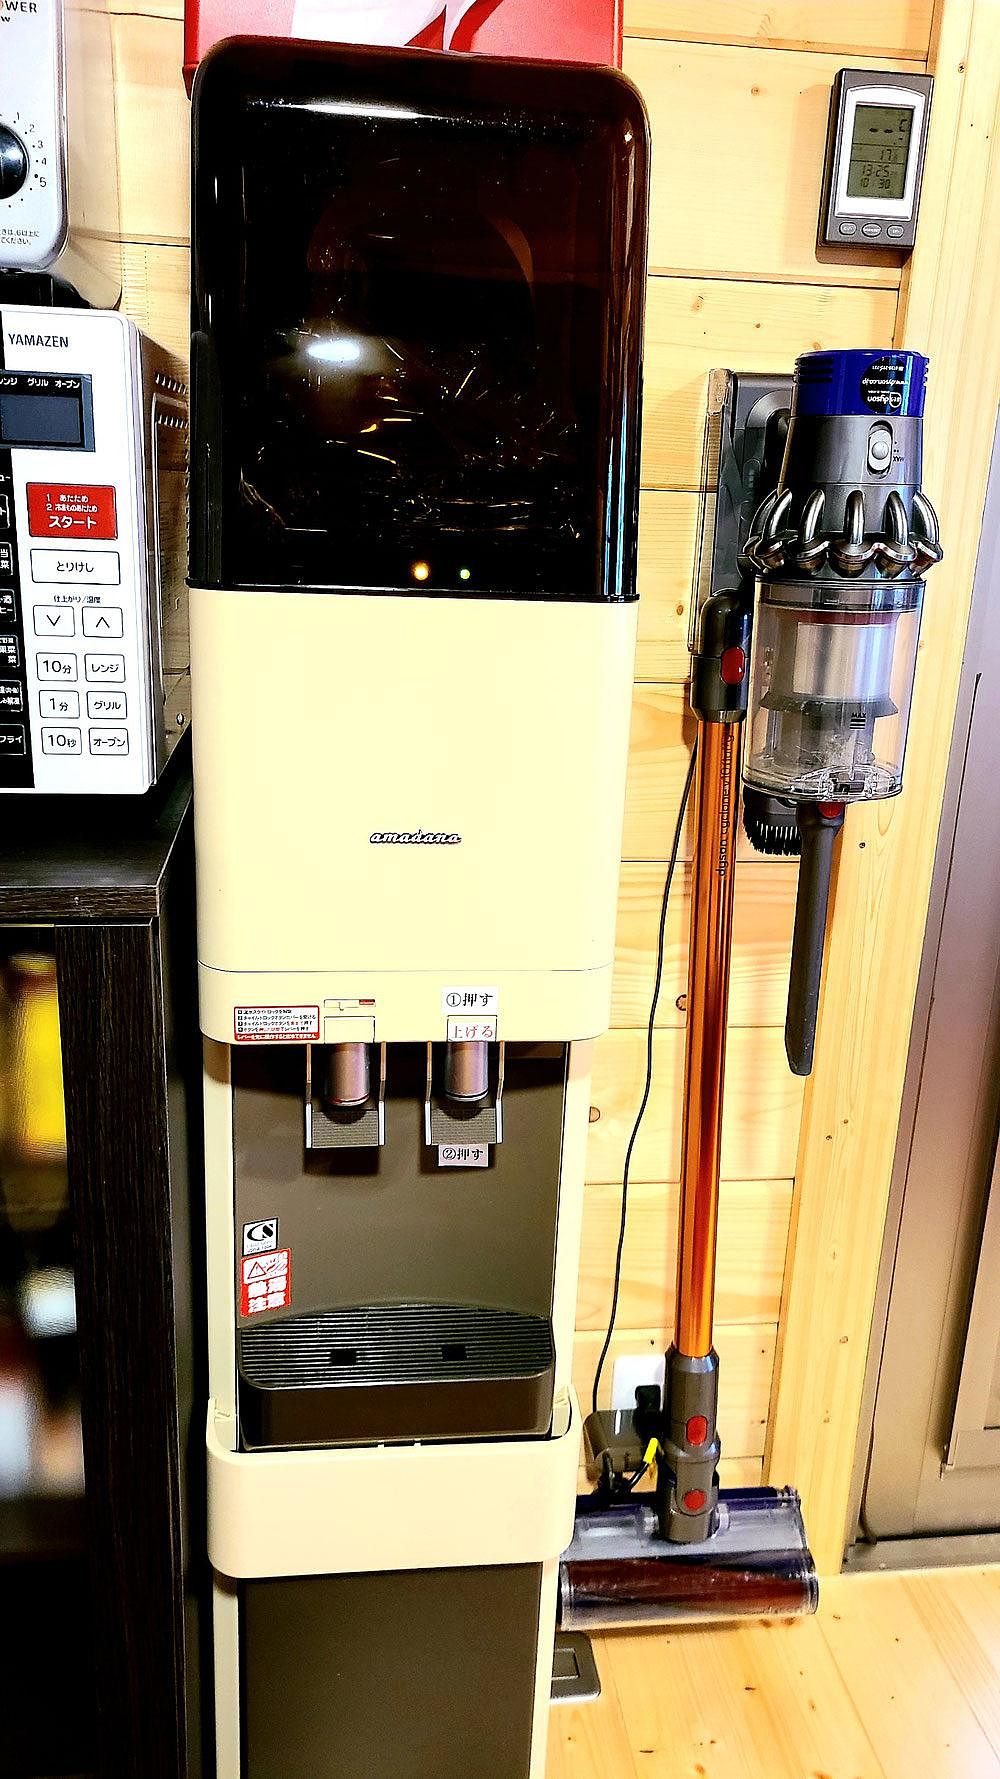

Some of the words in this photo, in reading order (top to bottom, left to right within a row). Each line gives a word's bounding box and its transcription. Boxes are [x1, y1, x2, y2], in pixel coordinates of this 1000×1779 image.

[38, 140, 44, 149] 3
[41, 158, 47, 166] 4
[39, 177, 47, 188] 5
[8, 333, 69, 348] YAMAZEN
[27, 377, 49, 387] グリル
[54, 380, 80, 389] オープン
[867, 394, 889, 405] dyson
[46, 493, 51, 502] 1
[59, 494, 89, 503] あたため
[46, 503, 53, 511] 2
[48, 515, 97, 530] スタート
[56, 560, 95, 573] とりけし
[43, 659, 72, 674] 10分
[92, 663, 119, 674] レンジ
[49, 697, 68, 711] 1分
[93, 700, 121, 711] グリル
[47, 734, 77, 748] 10秒
[93, 737, 126, 748] オープン
[370, 829, 462, 844] amadana
[715, 840, 728, 877] dyson
[446, 992, 494, 1008] ①押す
[451, 1025, 494, 1039] 上げる
[442, 1147, 484, 1161] ②押す
